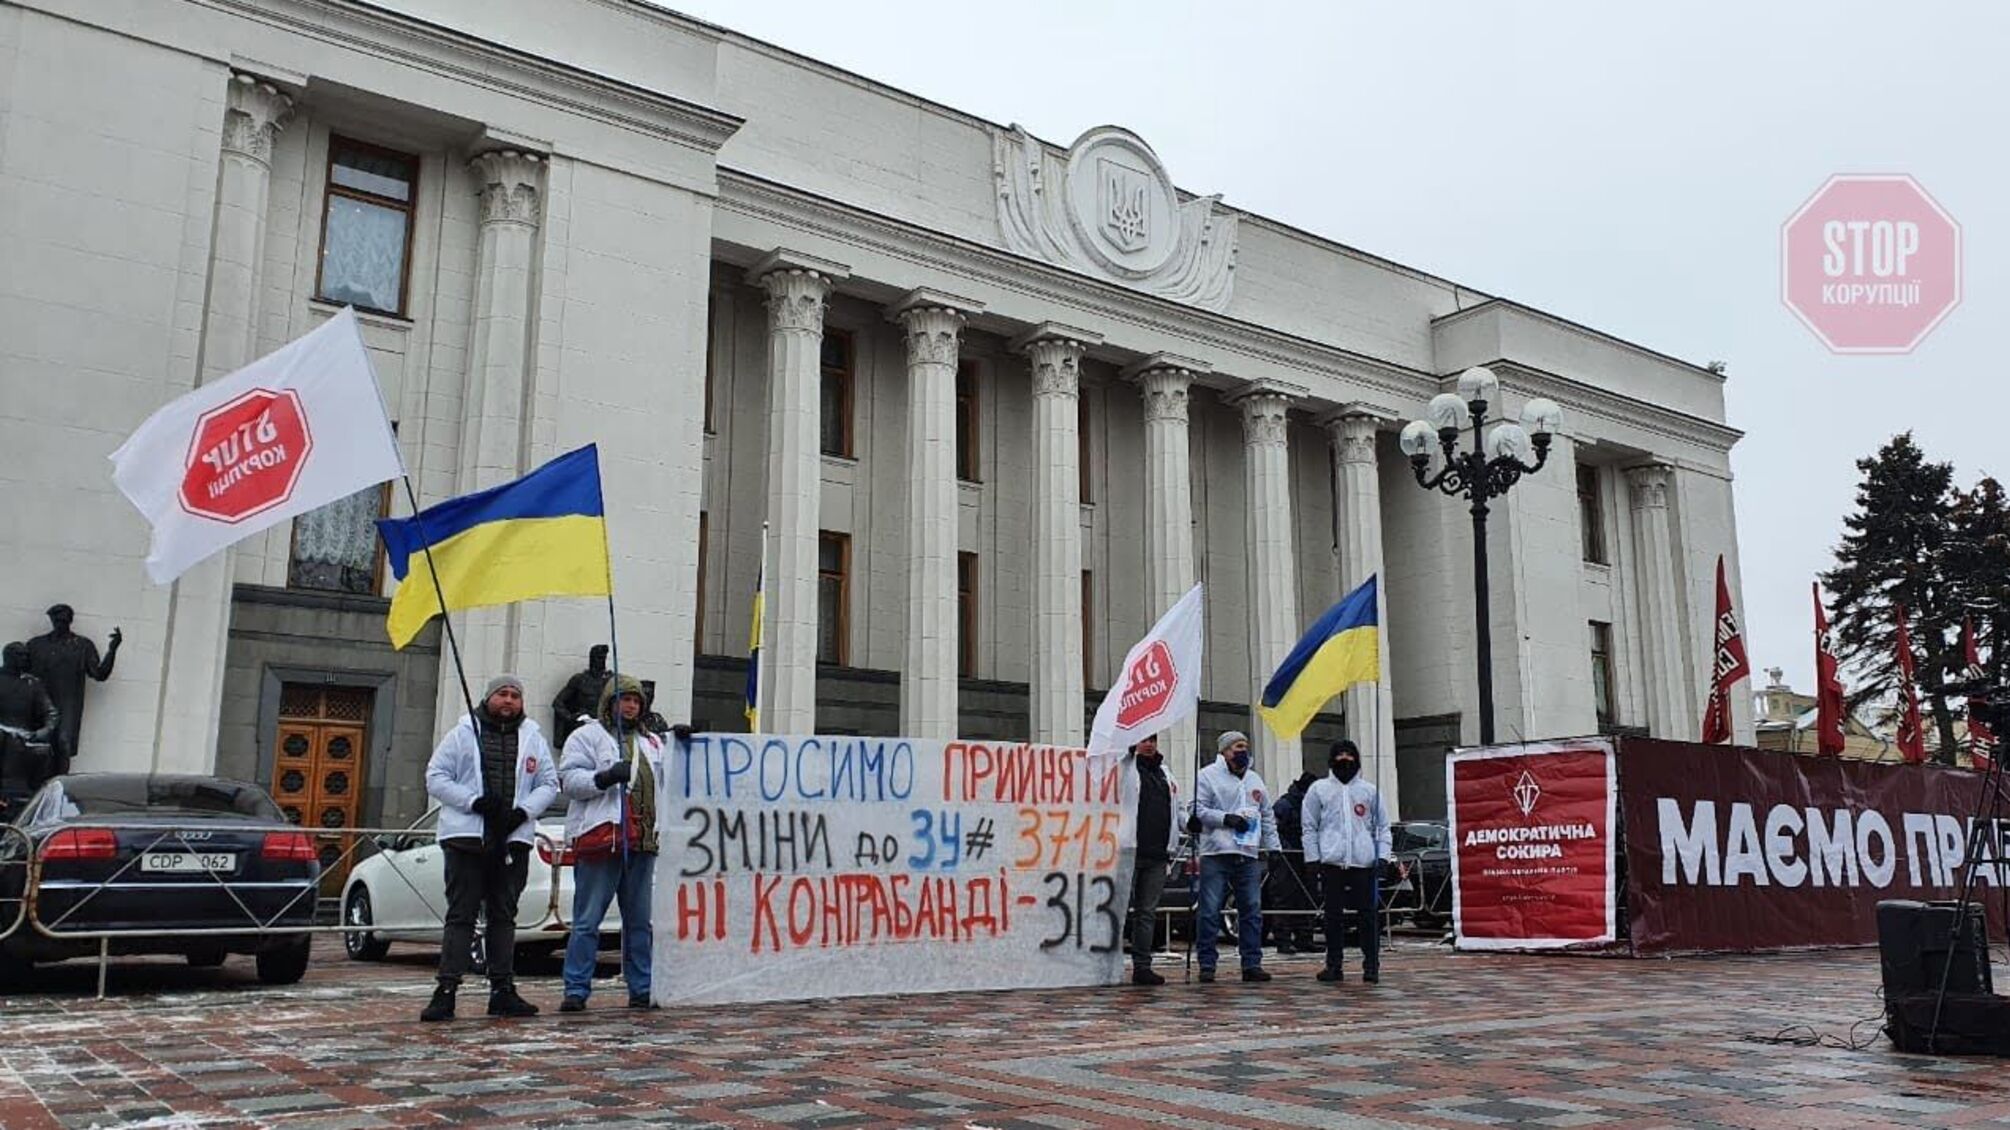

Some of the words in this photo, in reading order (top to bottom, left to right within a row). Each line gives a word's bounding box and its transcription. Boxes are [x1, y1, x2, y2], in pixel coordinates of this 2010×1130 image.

[683, 738, 913, 801] ПРОСИМО
[944, 743, 1119, 805] ПРИЙНЯТИ
[681, 807, 833, 877] ЗМІНИ
[1015, 809, 1120, 870] 3715
[1465, 823, 1596, 847] ДЕМОКРАТИЧНА
[1496, 844, 1562, 860] СОКИРА
[1657, 797, 1896, 889] МАЄМО
[149, 854, 183, 869] CDP
[201, 855, 229, 869] 062
